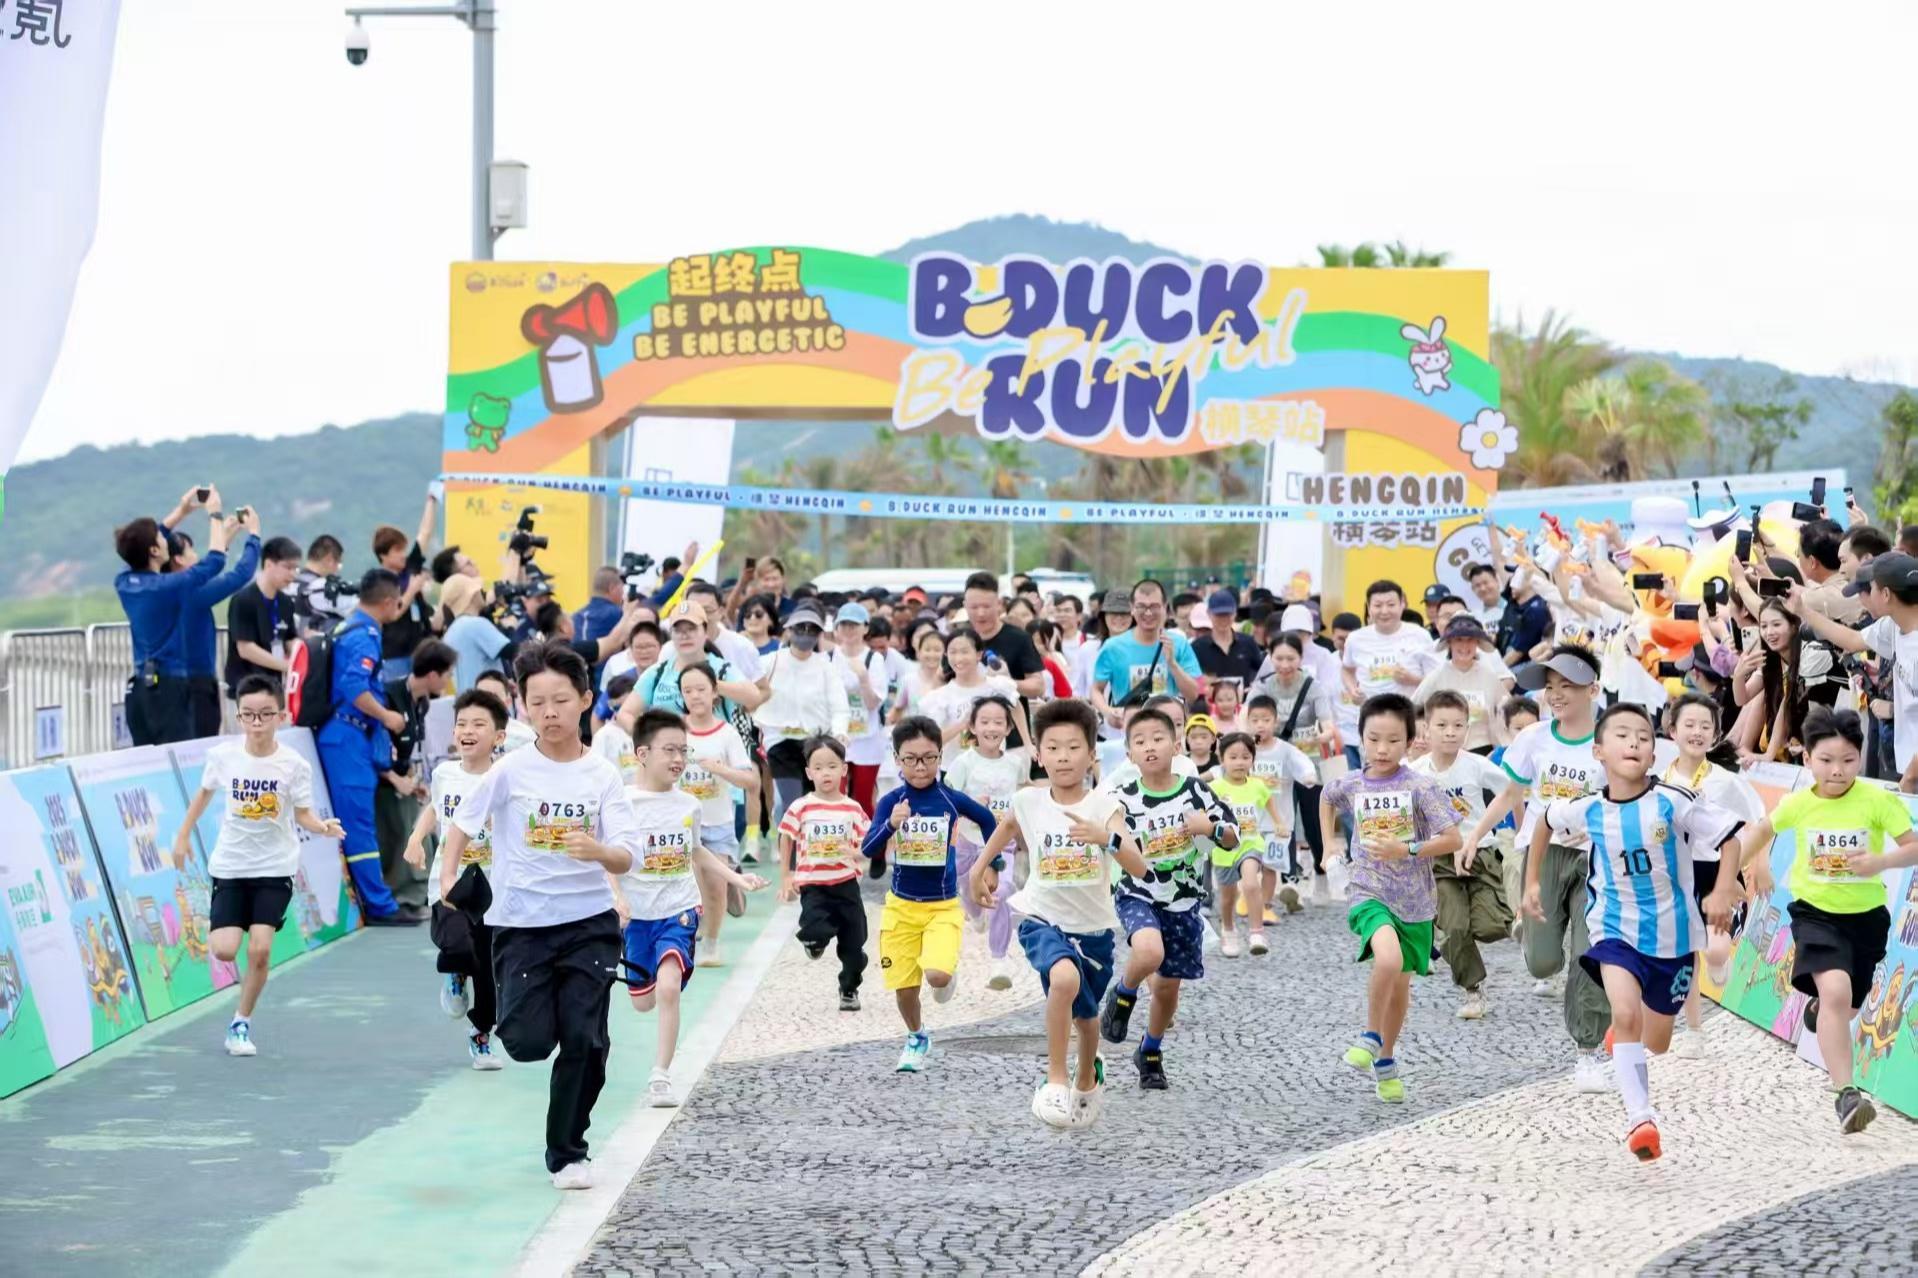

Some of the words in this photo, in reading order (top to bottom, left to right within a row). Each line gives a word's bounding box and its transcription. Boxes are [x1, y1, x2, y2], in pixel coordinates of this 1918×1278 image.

[669, 249, 800, 297] 起终点
[914, 256, 973, 338] B
[1003, 258, 1264, 347] DUCK
[652, 303, 689, 330] BE
[698, 296, 829, 326] PLAYFUL
[633, 333, 671, 360] BE
[682, 324, 846, 357] ENERGETIC
[900, 353, 994, 423] Be
[1016, 290, 1306, 416] Playful
[982, 355, 1189, 439] RUN
[667, 488, 731, 501] PLAYFUL
[785, 495, 845, 508] HENGQIN
[1302, 475, 1465, 507] HENGQIN
[903, 502, 940, 513] DUCK
[947, 504, 977, 515] RUN
[983, 505, 1047, 517] HENGQIN
[1110, 508, 1175, 518] PLAYFUL
[1229, 511, 1290, 519] HENGQIN
[1549, 763, 1587, 782] 0308
[243, 778, 278, 792] DUCK
[539, 802, 586, 818] 0763
[1363, 796, 1401, 810] 1281
[813, 824, 845, 835] 0335
[902, 821, 938, 834] 0306
[1148, 812, 1186, 832] 1374
[647, 833, 684, 848] 1875
[1816, 834, 1859, 848] 1864
[1619, 847, 1654, 877] 10
[1670, 965, 1693, 995] 85
